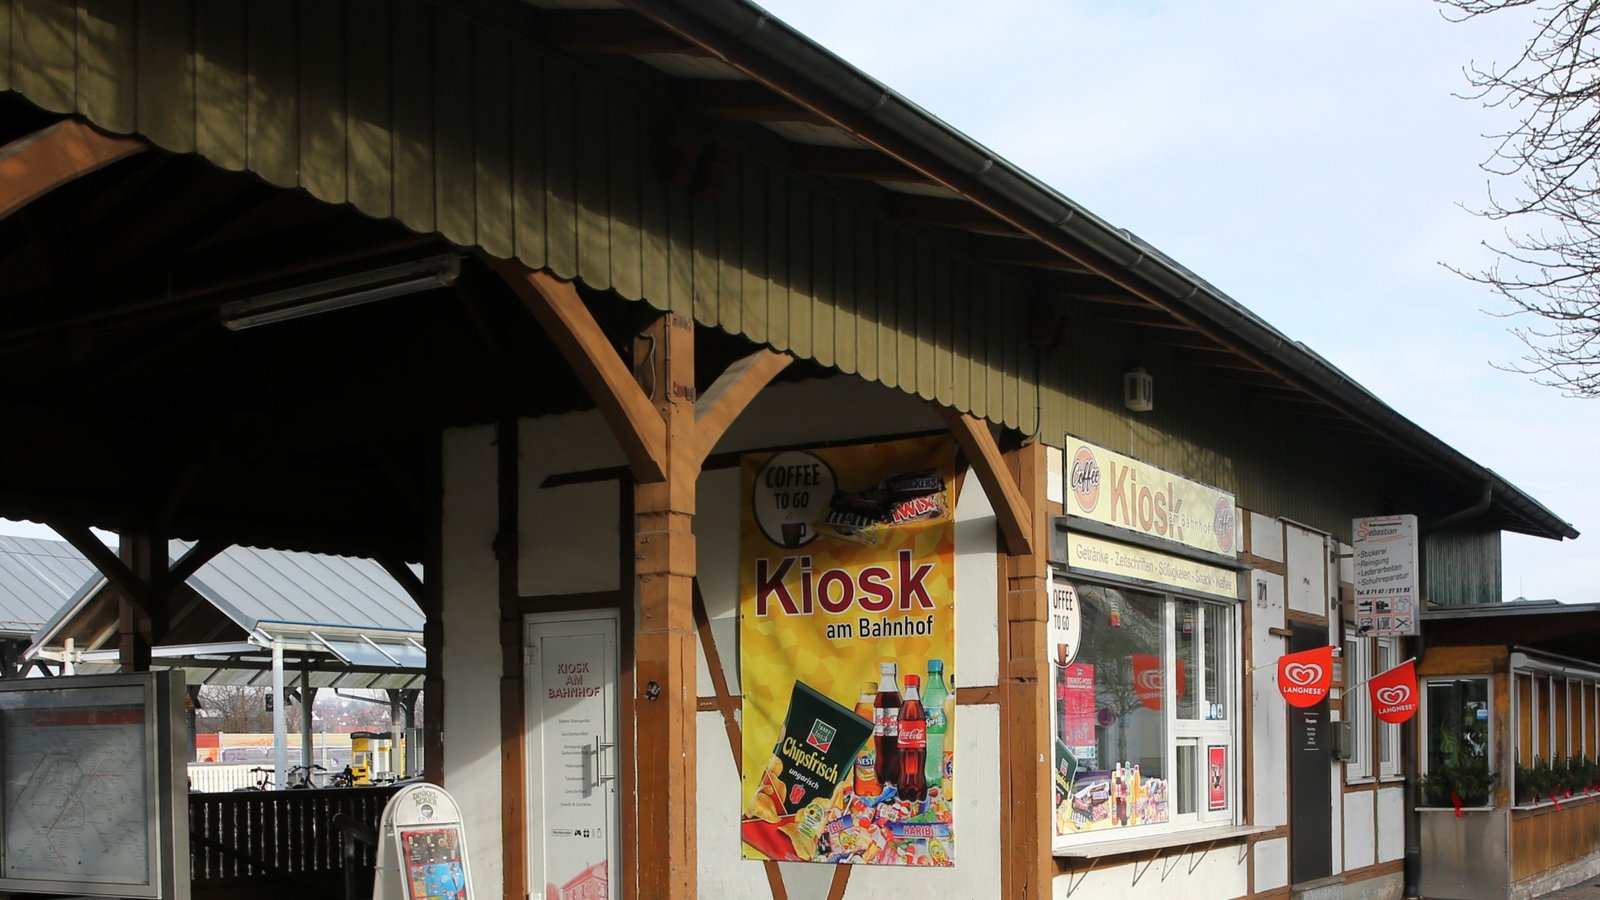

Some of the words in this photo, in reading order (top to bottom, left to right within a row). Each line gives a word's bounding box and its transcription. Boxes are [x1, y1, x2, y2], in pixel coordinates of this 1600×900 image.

[765, 463, 821, 489] COFFEE
[1071, 459, 1100, 495] Coffee
[774, 493, 791, 510] TO
[792, 491, 810, 508] GO
[1110, 461, 1184, 541] Kiosk
[1181, 513, 1211, 535] Bahnhof
[1076, 543, 1109, 564] Getränke
[755, 549, 936, 618] Kiosk
[1053, 588, 1073, 611] OFFEE
[827, 622, 852, 639] am
[859, 615, 934, 638] Bahnhof
[1054, 614, 1061, 630] TO
[1062, 615, 1069, 631] GO
[557, 662, 590, 674] KIOSK
[565, 675, 583, 686] AM
[1283, 686, 1322, 695] LANGNESE
[548, 686, 600, 699] BAHNHOF
[1378, 704, 1413, 715] LANGNESE
[782, 736, 839, 785] Chipsfrisch
[857, 757, 875, 767] NEST
[788, 768, 820, 790] ungarisch
[903, 825, 937, 837] HARIB
